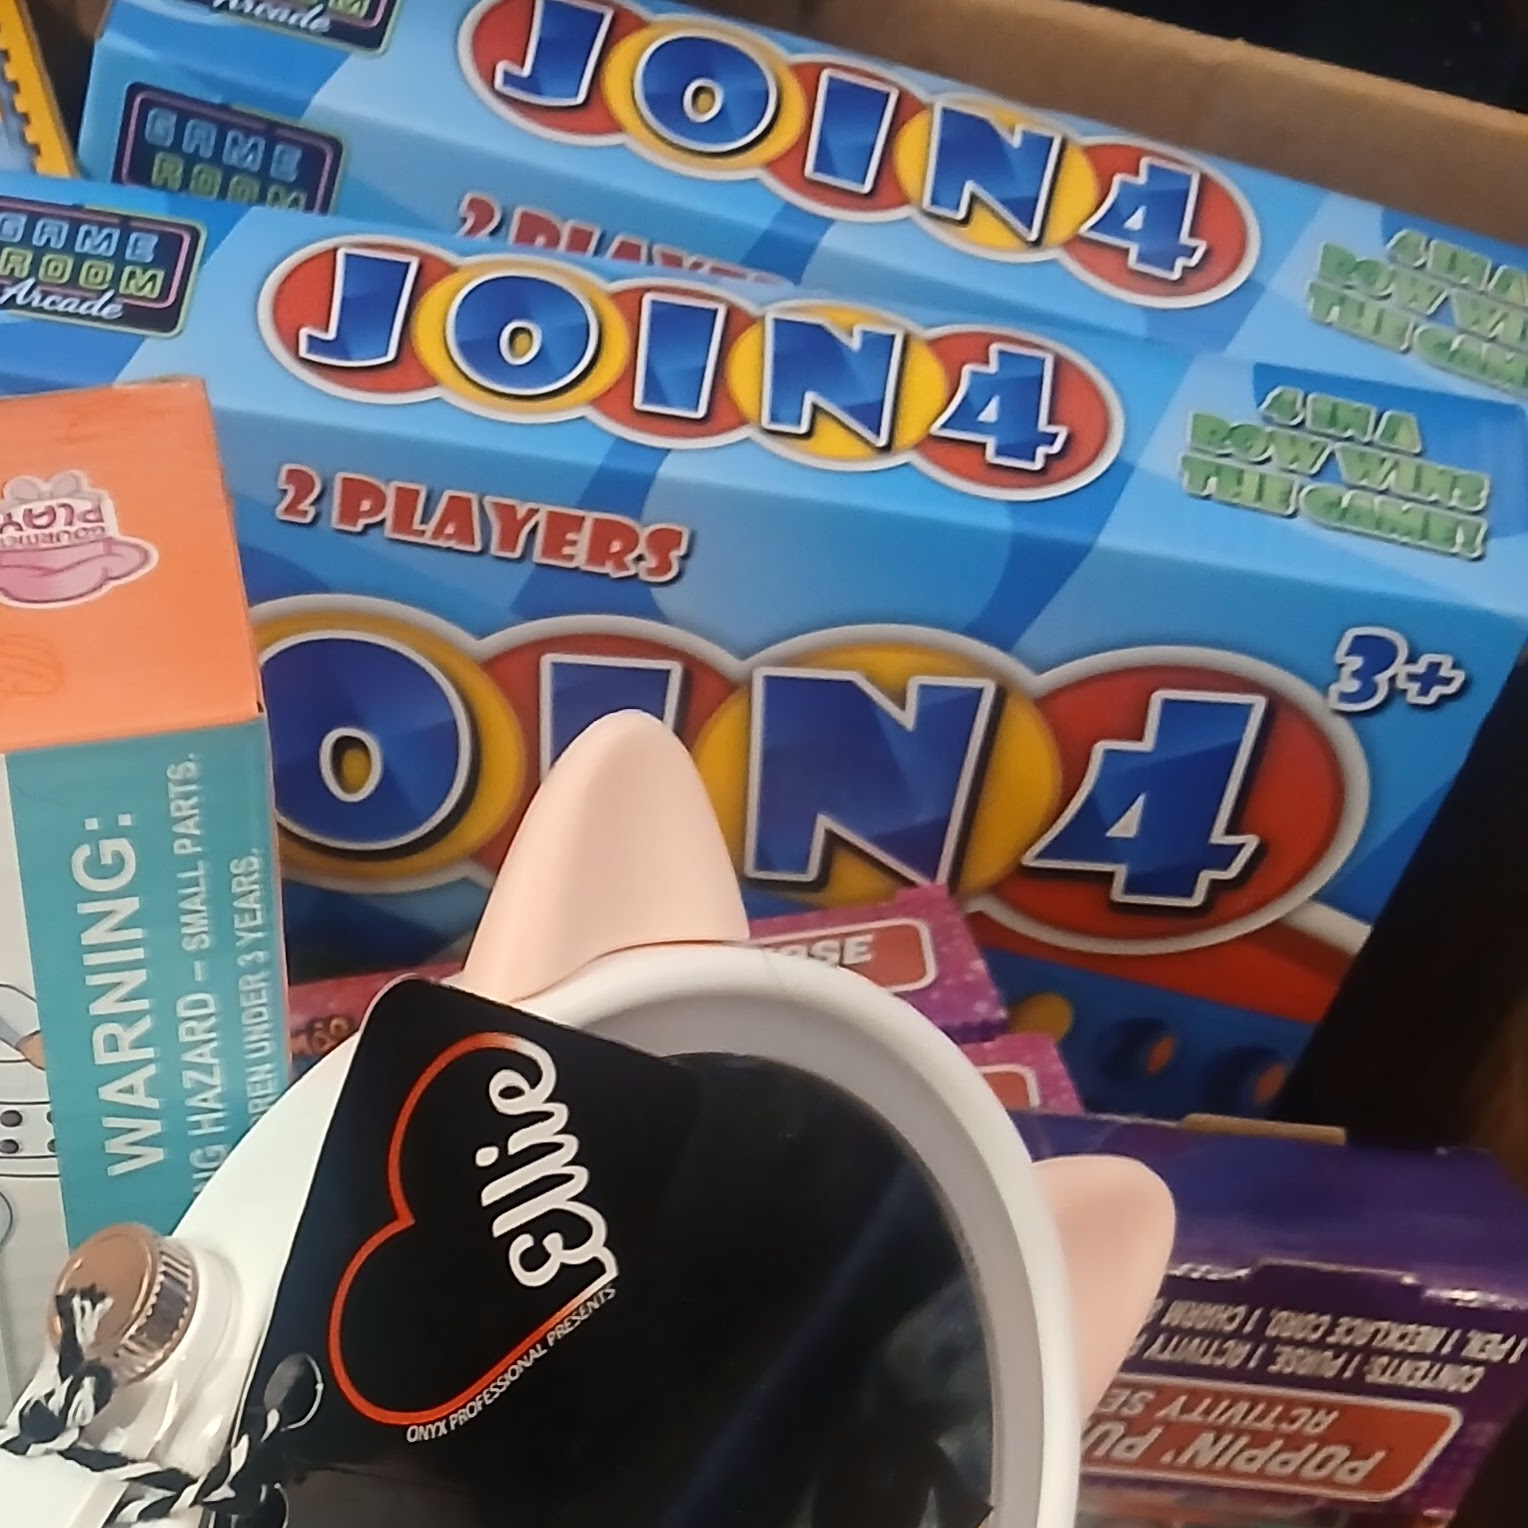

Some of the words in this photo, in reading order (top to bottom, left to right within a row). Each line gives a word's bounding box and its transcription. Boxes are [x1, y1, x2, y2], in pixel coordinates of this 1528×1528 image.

[494, 0, 1063, 245] JOIN
[1079, 156, 1206, 281] 4
[297, 247, 904, 450] JOIN
[928, 344, 1069, 471] 4
[275, 465, 322, 525] 2
[332, 472, 692, 585] PLAYERS
[1328, 625, 1466, 712] 3+
[166, 752, 204, 856] PARTS.
[1020, 689, 1269, 908] 4
[175, 859, 213, 953] SMALL
[229, 846, 269, 948] YEARS.
[71, 812, 166, 1178] WARNING:
[236, 949, 261, 970] 3
[176, 990, 228, 1137] HAZARD
[237, 976, 275, 1060] UNDER
[474, 1040, 621, 1288] Ellie
[405, 1417, 449, 1445] ONYX
[447, 1344, 549, 1434] PROFESSIONAL
[545, 1283, 619, 1349] PRESENTS
[1155, 1394, 1340, 1438] ACTIVITY
[1163, 1430, 1386, 1485] POPPIN'
